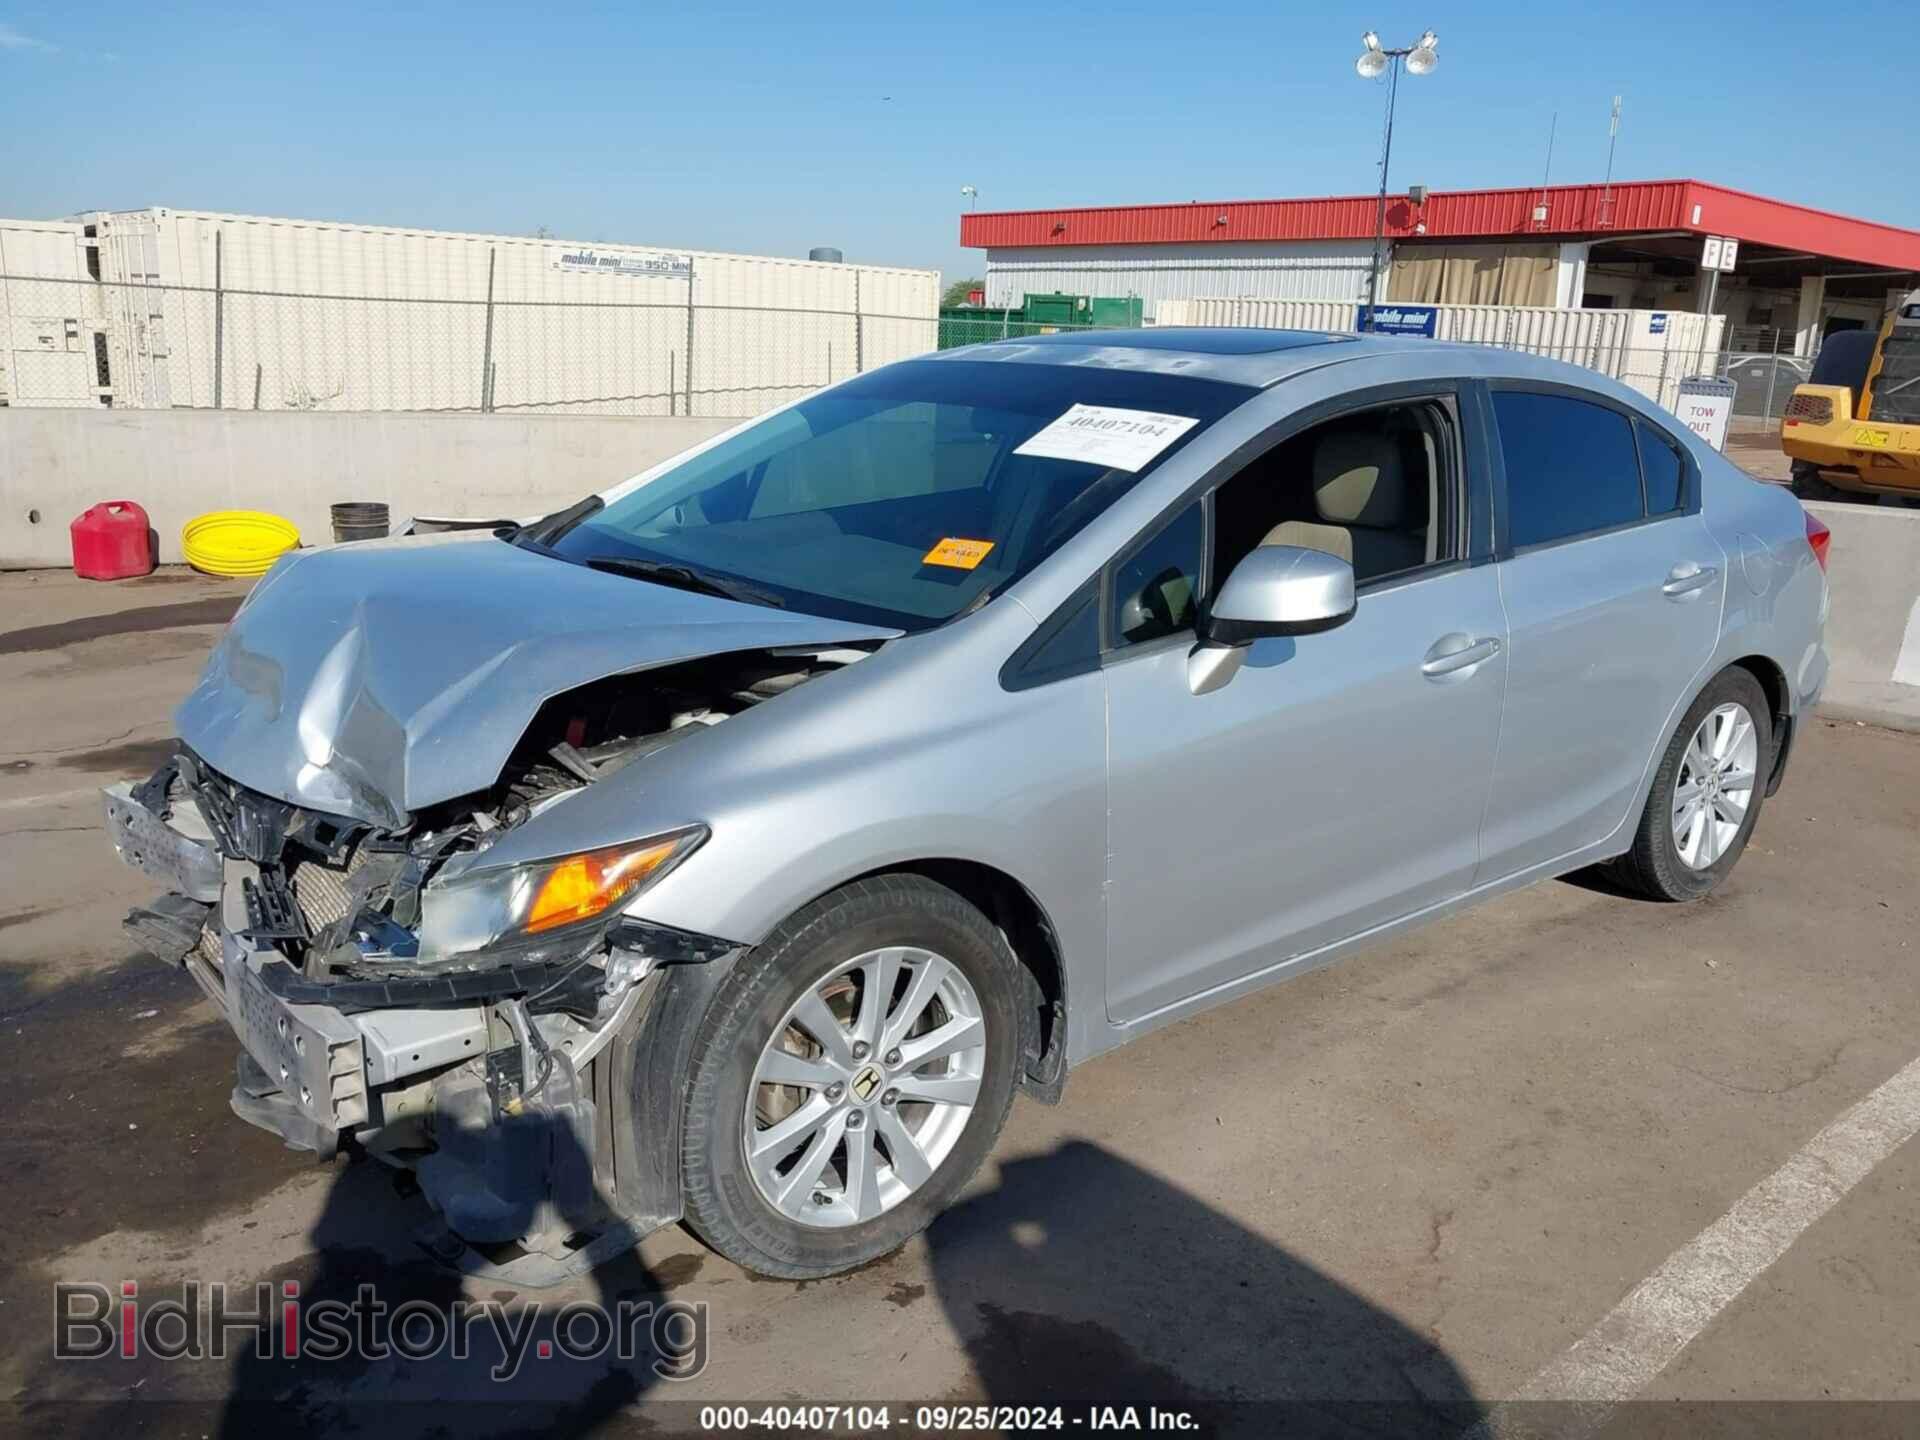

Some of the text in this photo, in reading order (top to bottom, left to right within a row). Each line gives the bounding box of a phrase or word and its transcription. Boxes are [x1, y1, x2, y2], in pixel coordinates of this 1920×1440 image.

[561, 250, 597, 266] mobile
[599, 255, 622, 267] mini
[1402, 311, 1431, 325] mini
[1690, 406, 1717, 418] TOW
[1069, 415, 1169, 438] 40407104
[1687, 421, 1712, 433] OUT
